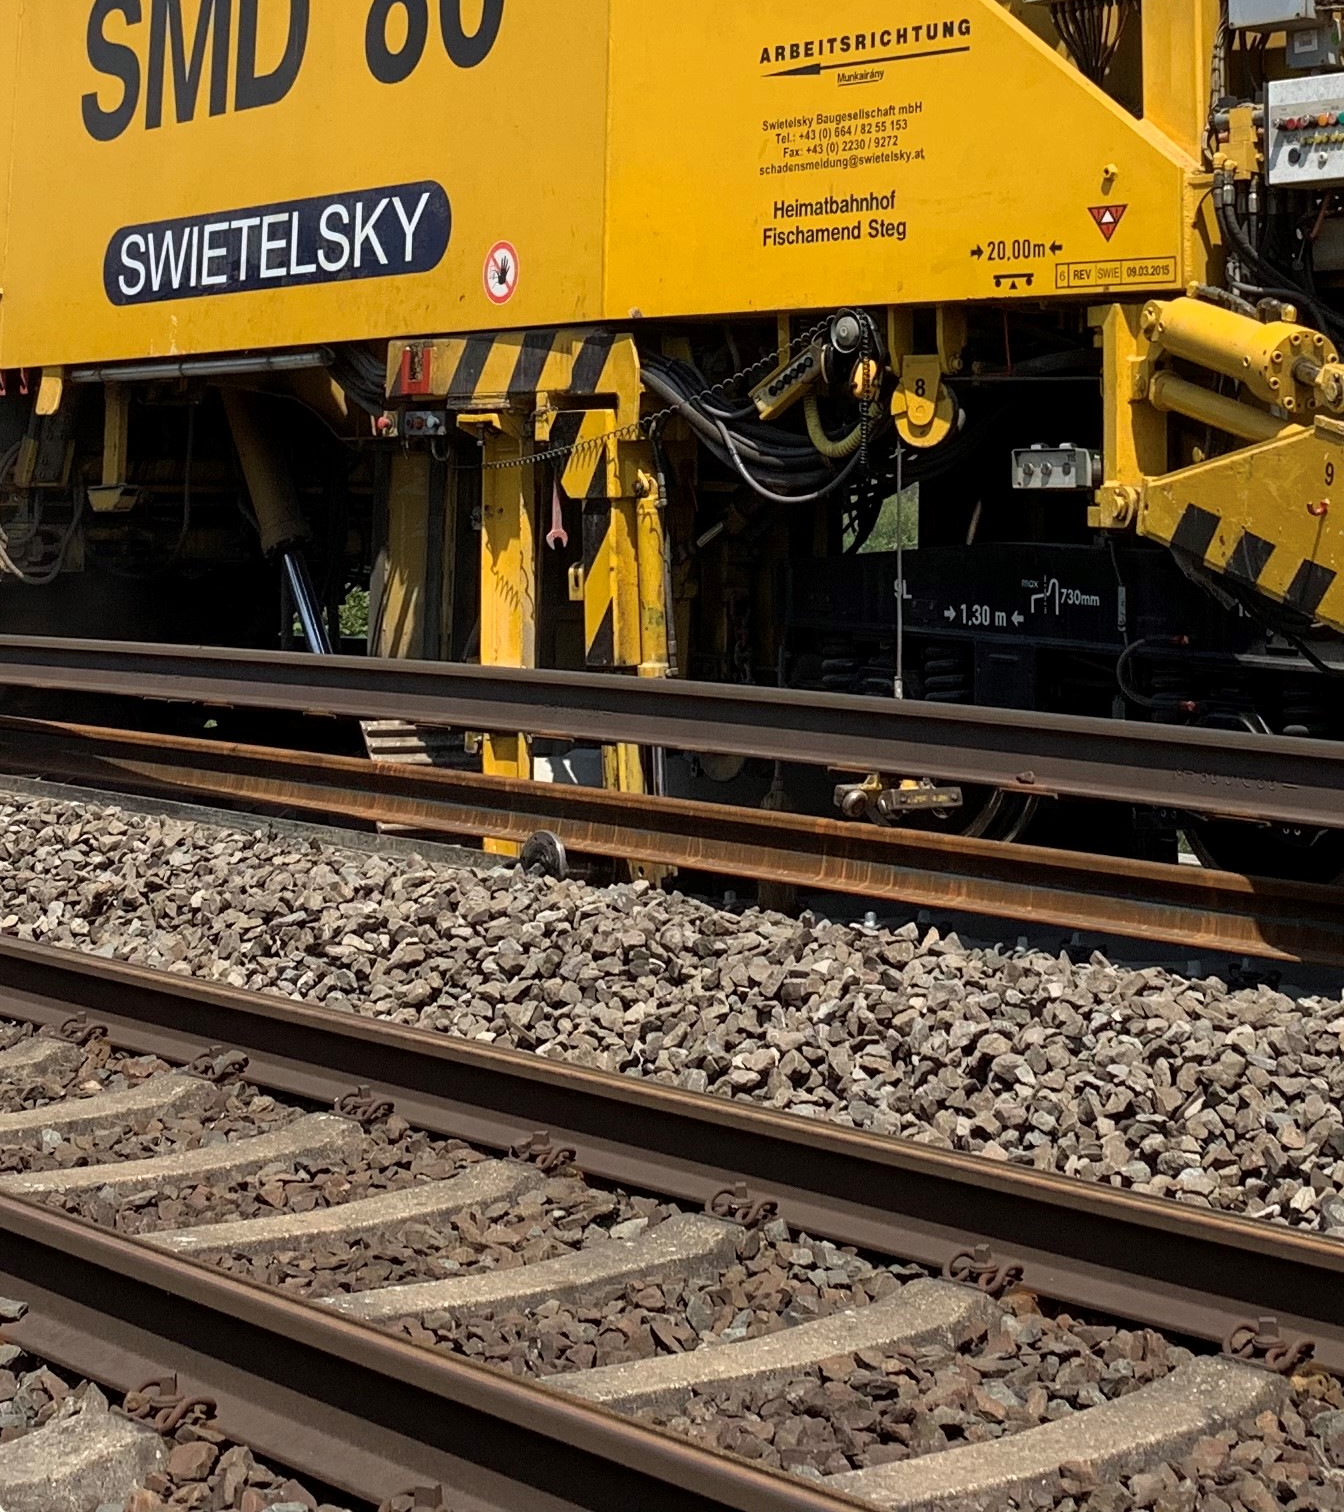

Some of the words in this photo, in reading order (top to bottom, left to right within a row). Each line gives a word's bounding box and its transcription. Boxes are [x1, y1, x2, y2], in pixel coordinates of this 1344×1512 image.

[759, 18, 971, 64] ARBEITSRICHTUNG
[837, 69, 885, 84] Munkairány
[762, 115, 814, 131] Swietelsky
[816, 104, 896, 126] Baugesellschaft
[898, 101, 923, 116] mbH
[775, 132, 796, 144] Tel.:
[799, 129, 816, 140] +43
[819, 127, 832, 142] (0)
[834, 125, 852, 138] 664
[860, 122, 873, 134] 82
[874, 121, 887, 133] 55
[890, 119, 908, 131] 153
[806, 143, 824, 155] +43
[826, 141, 839, 156] (0)
[841, 139, 866, 152] 2230
[873, 135, 899, 148] 9272
[759, 147, 925, 176] schadensmeldung@swietelsky.at
[773, 189, 896, 219] Heimatbahnhof
[118, 192, 430, 296] SWIETELSKY
[763, 220, 862, 247] Fischamend
[868, 218, 907, 241] Steg
[987, 239, 1046, 262] 20,00m
[1059, 270, 1066, 281] 6
[1073, 269, 1092, 281] REV
[1097, 267, 1120, 280] SWIE
[1126, 264, 1170, 278] 09.03.2015
[914, 378, 926, 398] 8
[1325, 461, 1334, 486] 9
[1060, 589, 1100, 607] 730mm
[960, 603, 990, 626] 1,30
[995, 610, 1007, 627] m
